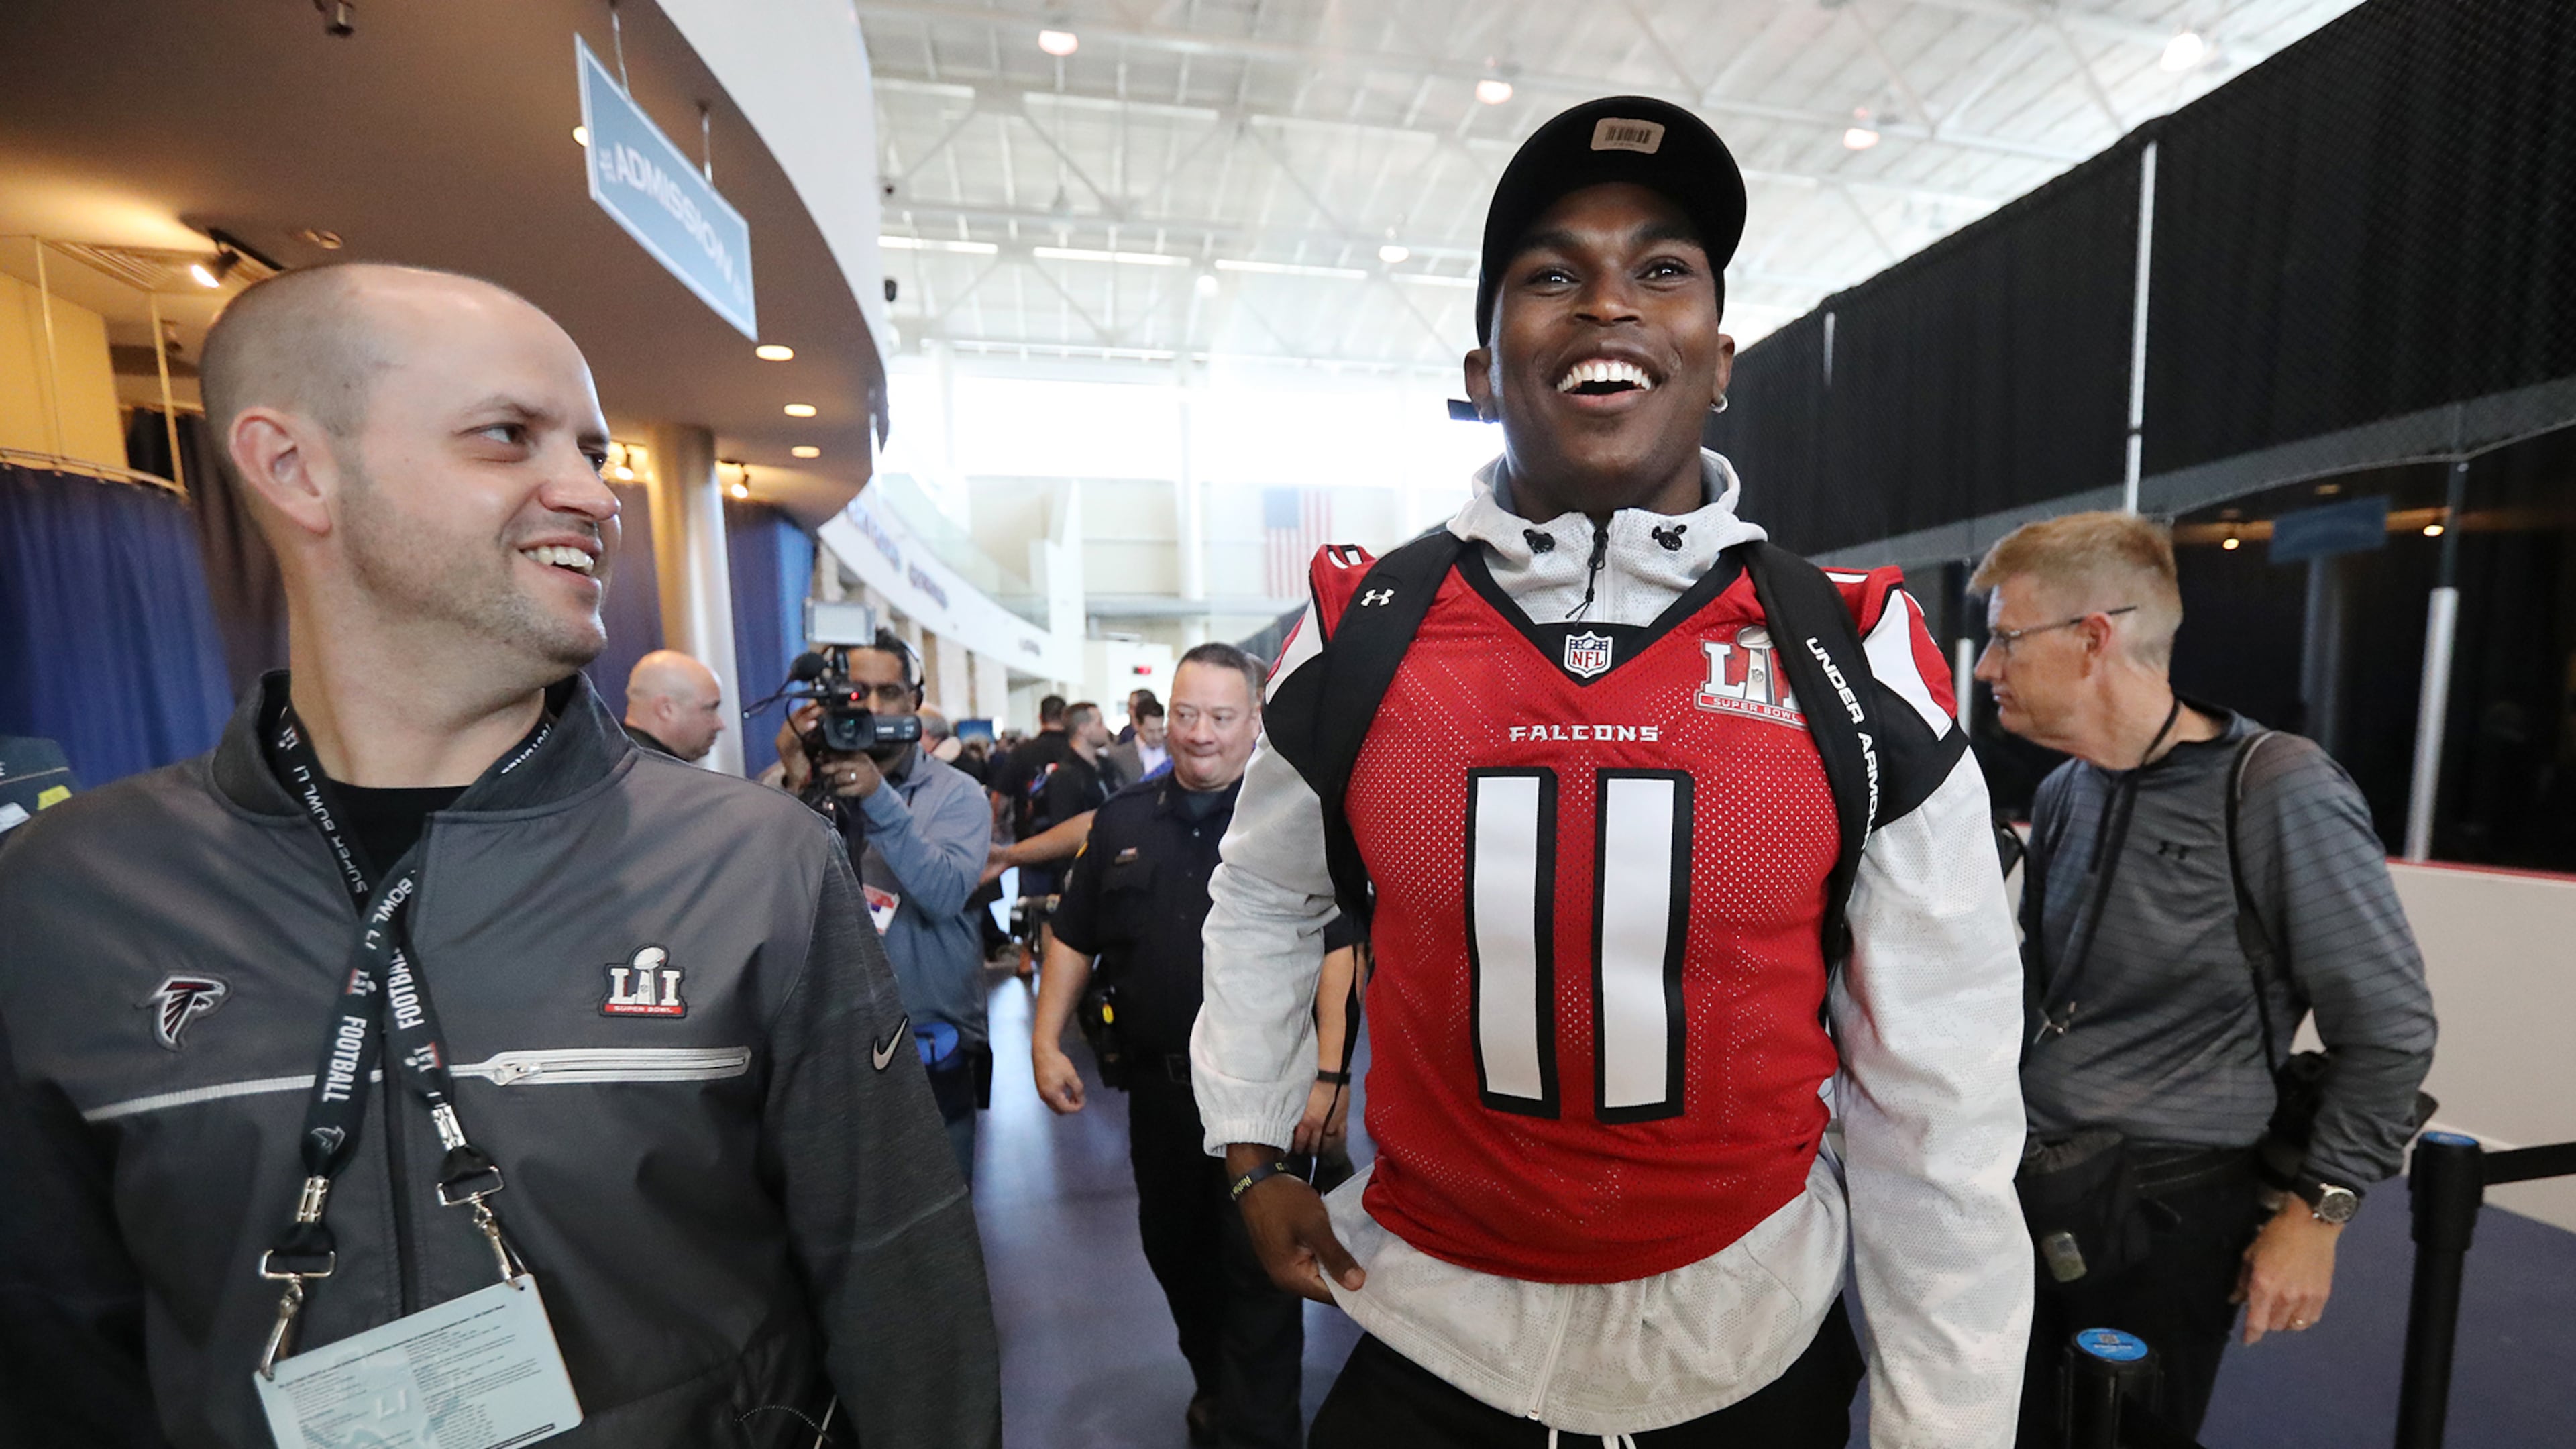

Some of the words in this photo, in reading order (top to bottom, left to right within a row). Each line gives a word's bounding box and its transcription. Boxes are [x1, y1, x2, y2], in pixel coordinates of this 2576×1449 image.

[613, 142, 734, 283] ADMISSION
[1572, 651, 1603, 668] NFL
[1806, 637, 1865, 724] UNDER
[1509, 724, 1659, 742] FALCONS
[1713, 698, 1758, 712] SUPER
[1763, 706, 1799, 721] BOWL
[303, 784, 335, 832] BOWL
[331, 835, 368, 894] SUPER
[371, 877, 413, 924] BOWL
[1464, 765, 1695, 1126] 11
[322, 1015, 368, 1103] FOOTBALL
